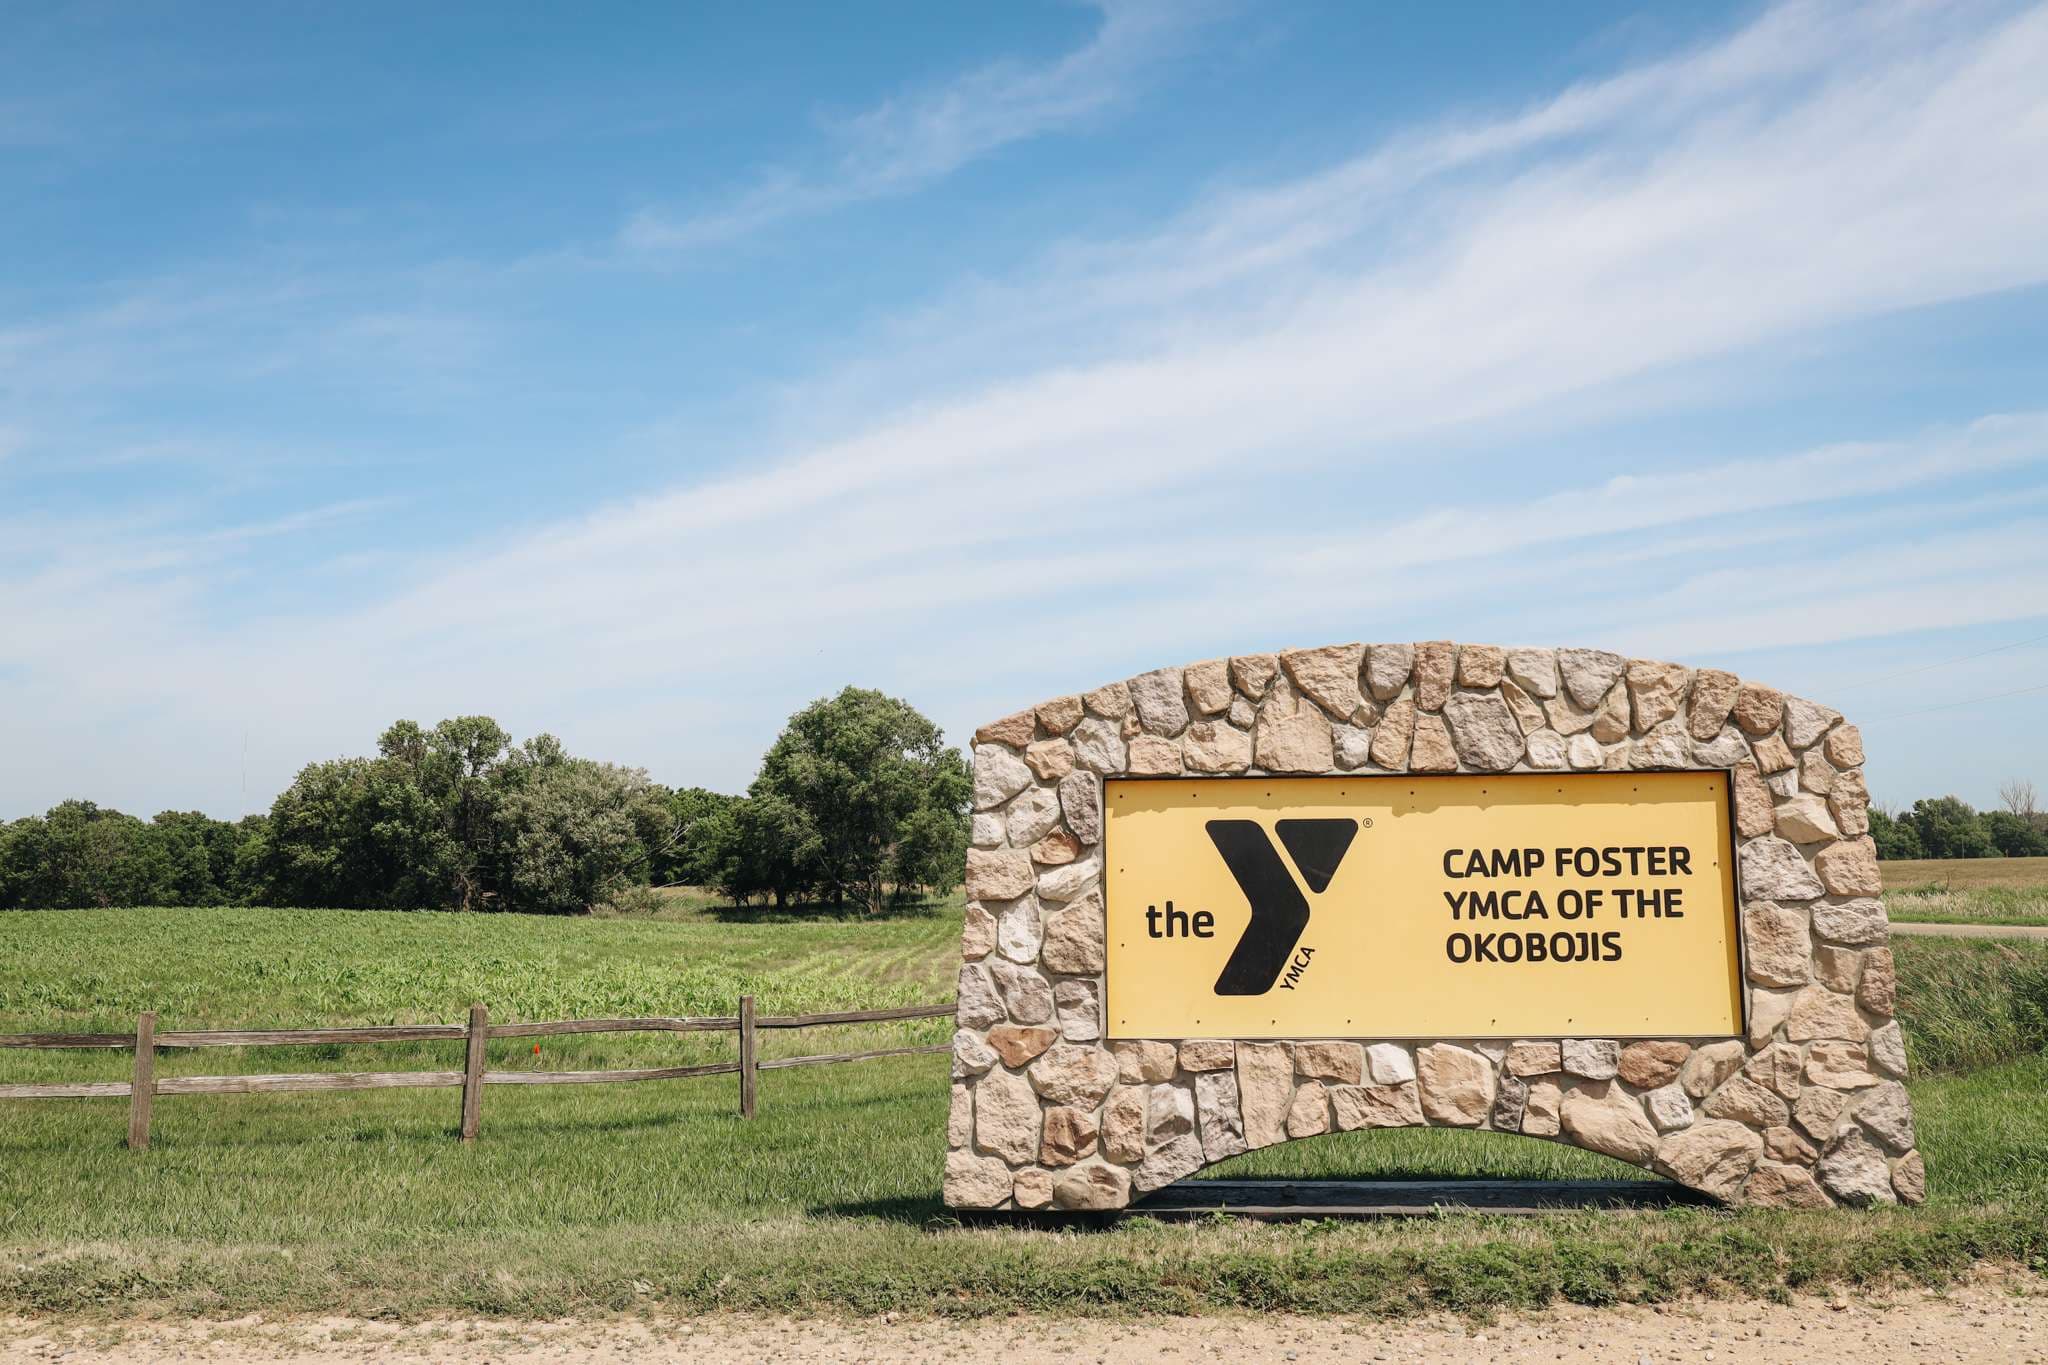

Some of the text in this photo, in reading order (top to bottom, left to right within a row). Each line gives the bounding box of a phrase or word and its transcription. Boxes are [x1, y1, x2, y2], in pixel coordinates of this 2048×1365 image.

[1443, 846, 1693, 879] CAMP FOSTER
[1145, 900, 1215, 939] the
[1443, 888, 1684, 921] YMCA OF THE
[1446, 931, 1622, 964] OKOBOJIS
[1279, 946, 1316, 991] YMCA
